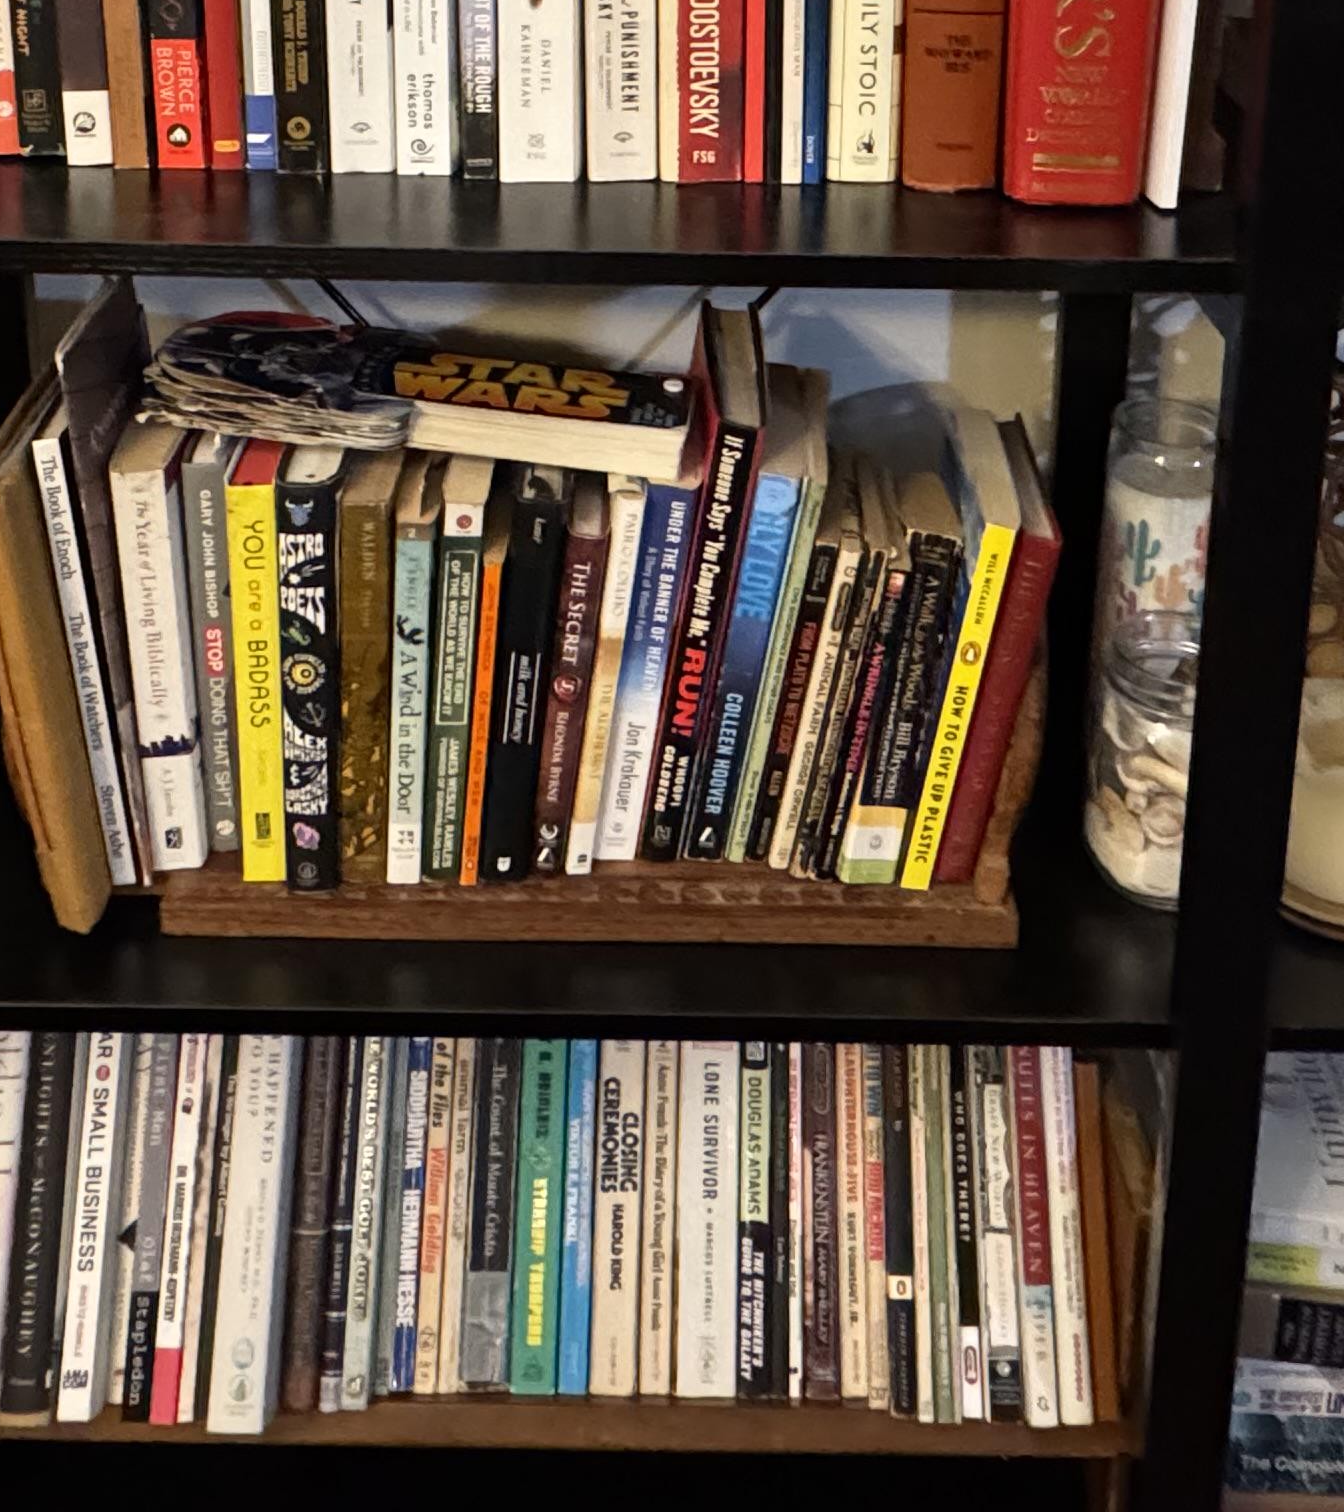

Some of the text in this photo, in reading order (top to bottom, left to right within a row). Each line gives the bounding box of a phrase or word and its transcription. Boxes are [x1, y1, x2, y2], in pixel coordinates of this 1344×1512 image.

[155, 47, 175, 115] BROWN
[177, 50, 195, 113] PIERCE
[620, 12, 639, 112] PUNISHMENT
[858, 44, 878, 116] STOIC
[693, 150, 715, 164] FSG
[393, 373, 629, 419] WARS
[395, 354, 617, 389] STAR
[205, 629, 223, 672] STOP
[243, 520, 271, 728] YOU are a BADASS
[562, 561, 592, 667] THE SECRET
[671, 646, 706, 738] RUN!
[615, 720, 646, 814] Jon Krakauer
[705, 693, 744, 814] COLLEEN HOOVER
[914, 685, 969, 863] HOW TO GIVE UP PLASTIC
[601, 1077, 621, 1193] CEREMONIES
[620, 1112, 639, 1193] CLOSING
[701, 1062, 721, 1200] LONE SURVIVOR
[748, 1079, 762, 1215] DOUGLAS ADAMS
[77, 1088, 110, 1273] SMALL BUSINESS
[129, 1296, 149, 1406] Stapledon
